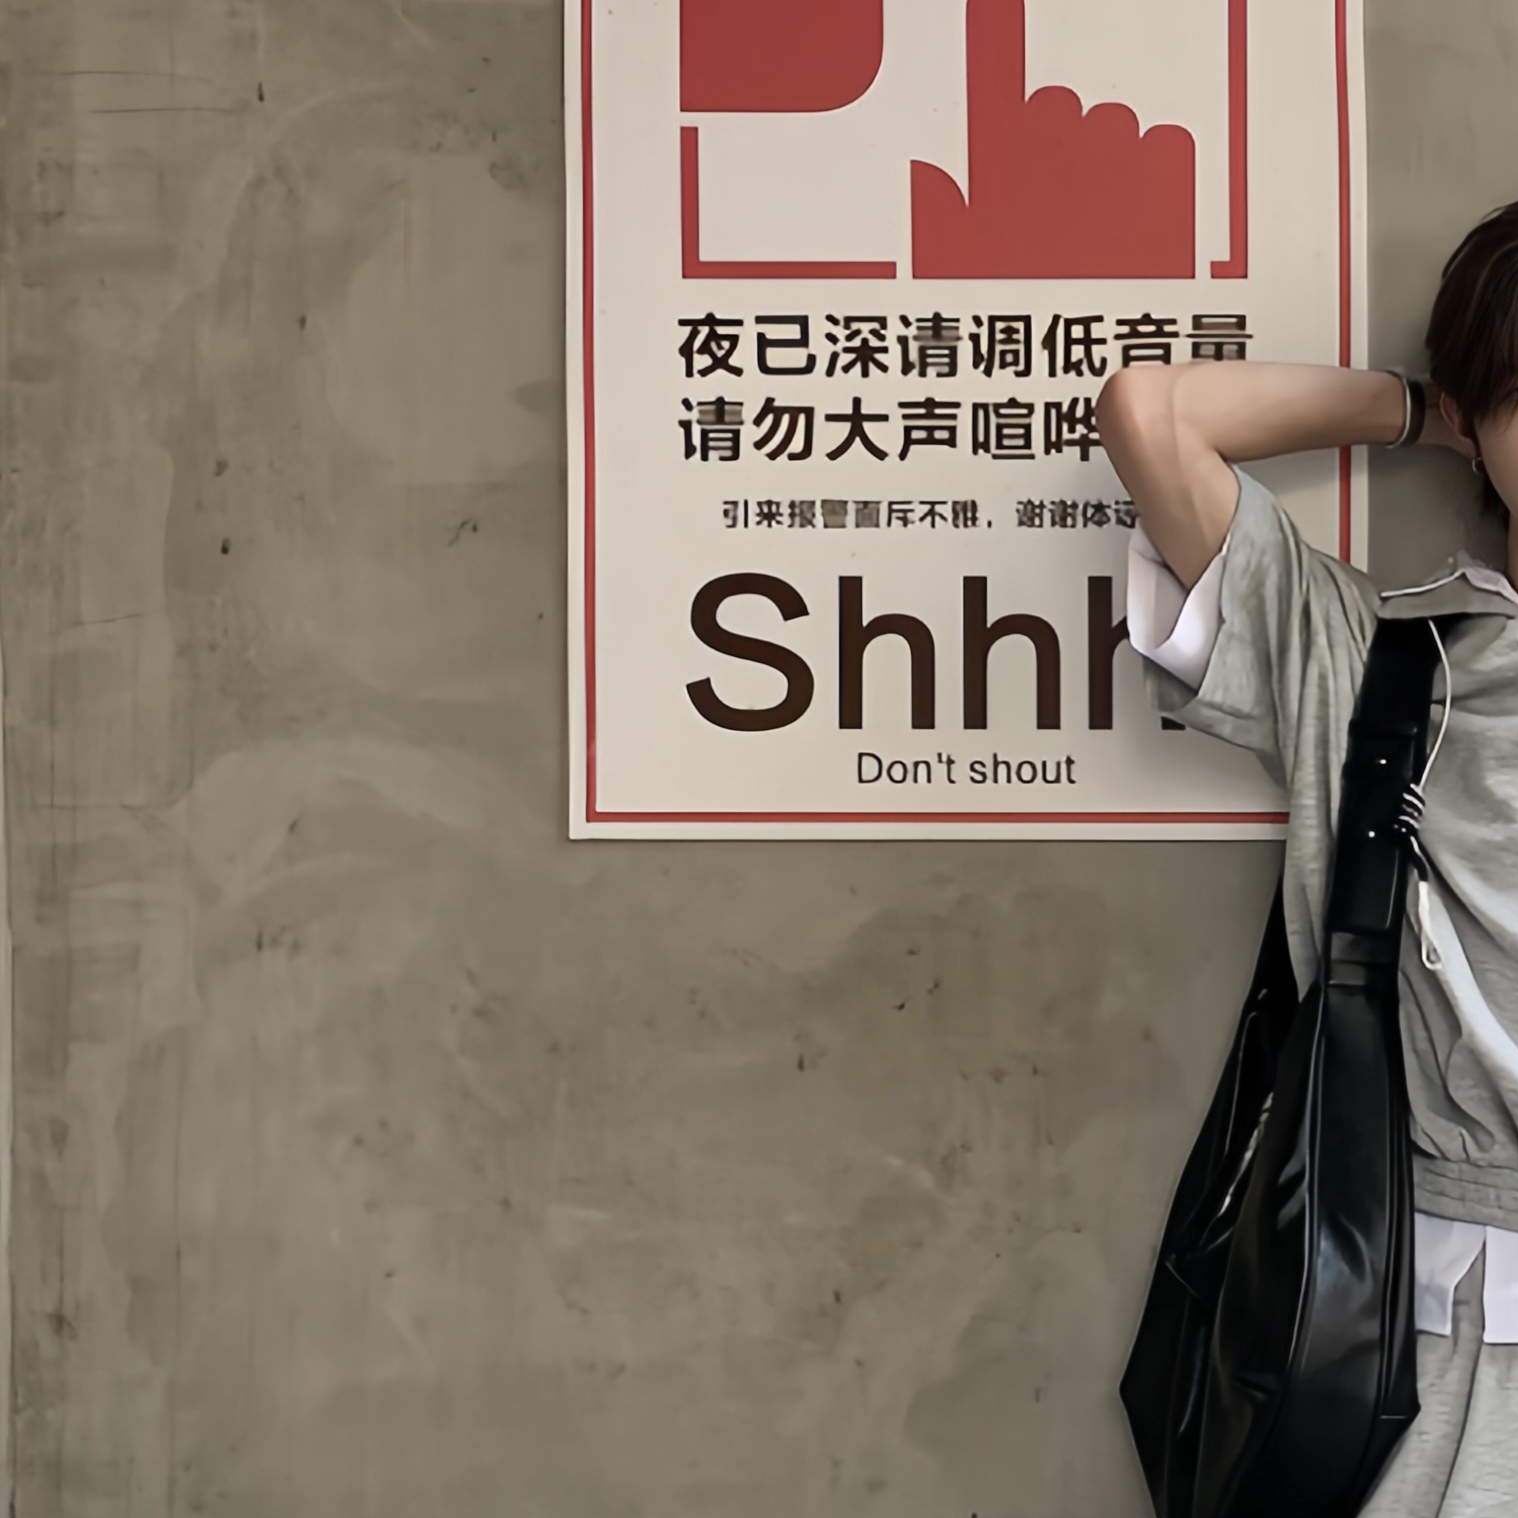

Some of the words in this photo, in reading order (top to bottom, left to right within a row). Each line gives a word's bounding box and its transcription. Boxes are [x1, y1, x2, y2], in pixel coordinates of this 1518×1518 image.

[677, 311, 1254, 379] 夜已深请调低音量
[677, 395, 1099, 463] 请勿大声喧哗
[857, 751, 957, 785] Don't
[969, 751, 1077, 785] shout
